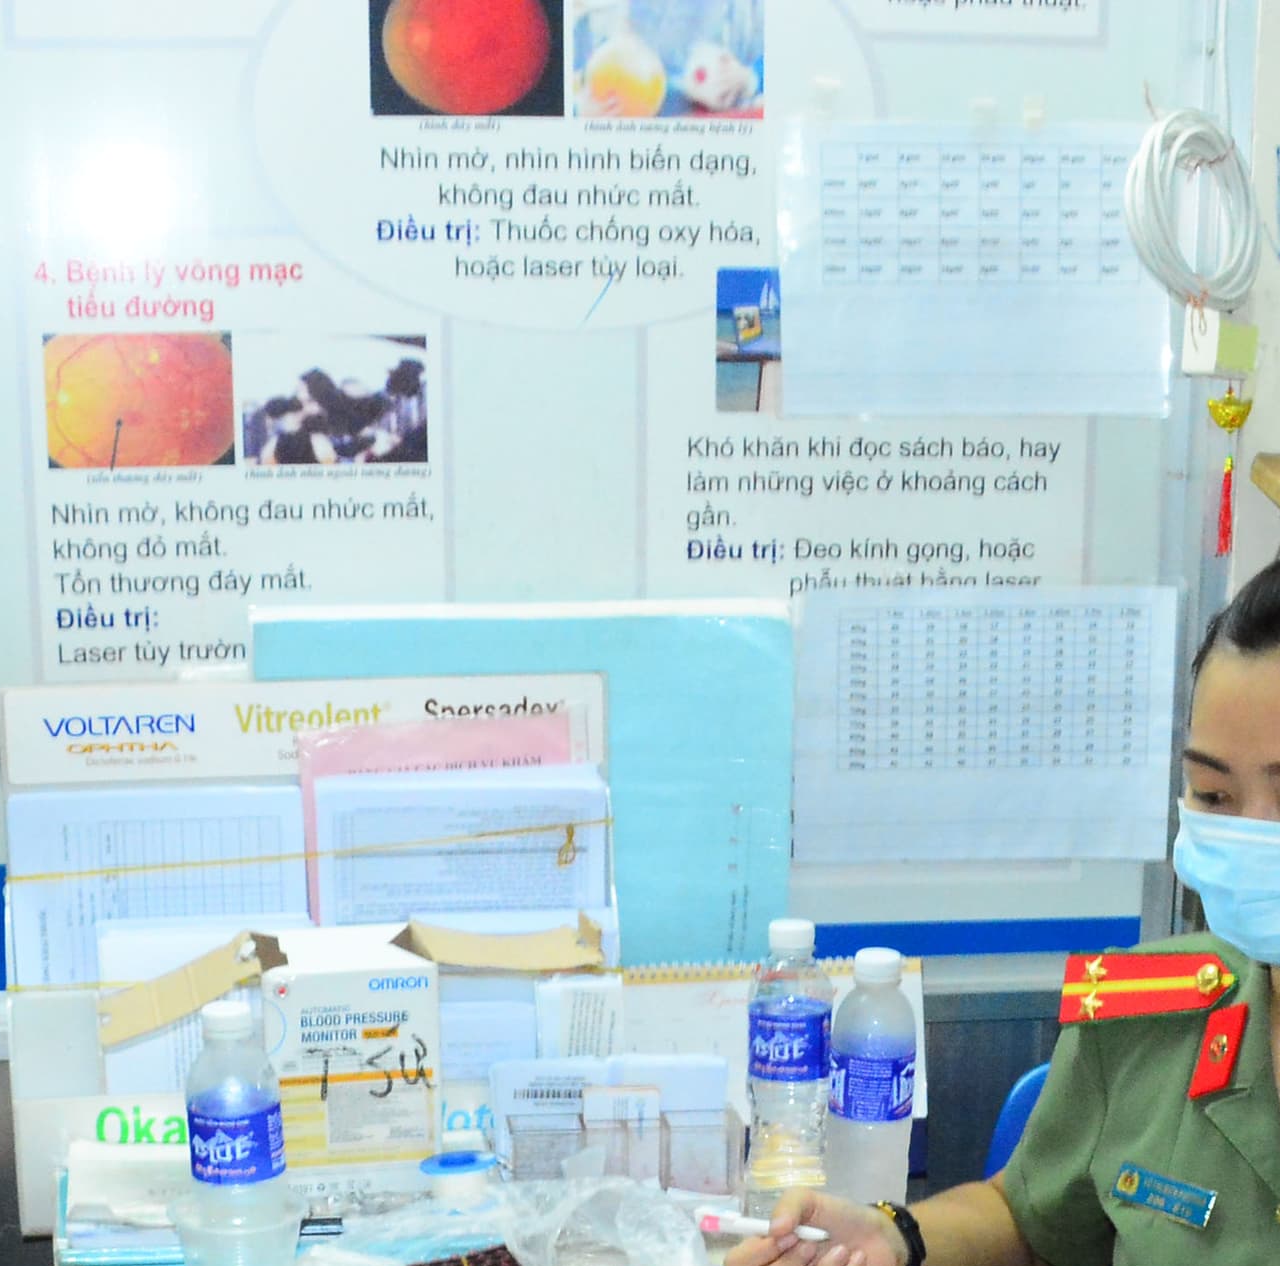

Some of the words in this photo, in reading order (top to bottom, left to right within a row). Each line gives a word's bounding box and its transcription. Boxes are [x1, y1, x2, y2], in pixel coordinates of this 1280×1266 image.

[689, 148, 757, 177] dạng,
[438, 183, 513, 210] không
[522, 183, 568, 206] đau
[375, 214, 436, 242] Điều
[445, 220, 480, 247] trị:
[490, 213, 567, 242] Thuốc
[575, 213, 650, 247] chống
[658, 224, 700, 247] oxy
[249, 261, 303, 287] mạc
[523, 255, 583, 278] laser
[687, 435, 734, 458] Khó
[808, 436, 841, 457] khi
[849, 436, 892, 462] đọc
[899, 436, 954, 457] sách
[1019, 436, 1062, 463] hay
[822, 471, 869, 496] việc
[993, 471, 1047, 492] cách
[175, 499, 249, 527] không
[258, 498, 303, 522] đau
[53, 537, 128, 565] không
[686, 533, 743, 560] Điều
[752, 538, 785, 565] trị:
[794, 537, 842, 559] Đeo
[850, 536, 898, 560] kính
[56, 602, 115, 630] Điều
[124, 605, 160, 632] trị:
[58, 642, 127, 665] Laser
[179, 638, 247, 661] trườn
[43, 713, 196, 738] VOLTAREN
[235, 701, 382, 734] Vitreolent
[300, 1013, 342, 1028] BLOOD
[345, 1010, 409, 1025] PRESSURE
[301, 1028, 358, 1043] MONITOR
[96, 1105, 188, 1145] Oka
